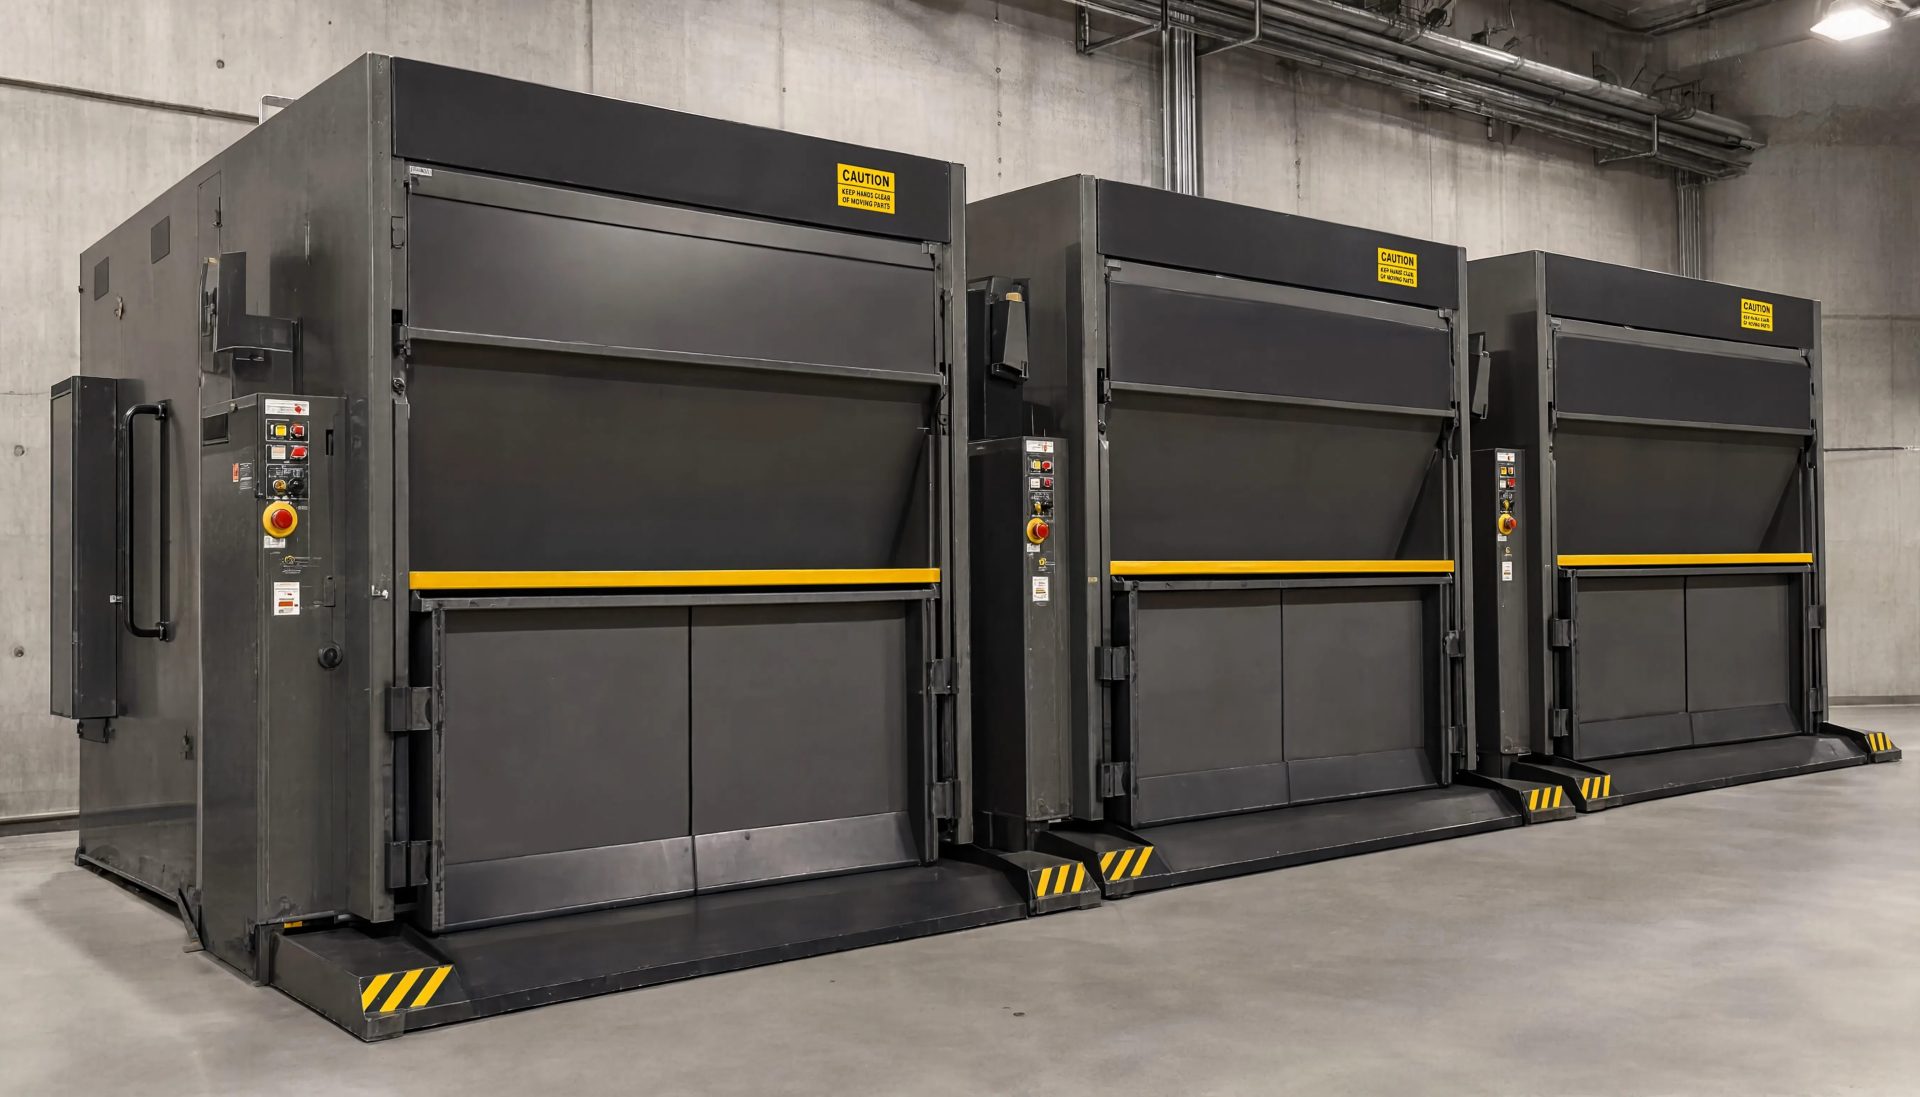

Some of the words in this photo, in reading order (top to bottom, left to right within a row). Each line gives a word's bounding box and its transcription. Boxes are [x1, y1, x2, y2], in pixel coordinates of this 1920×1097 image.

[843, 169, 890, 188] CAUTION
[842, 188, 856, 196] KEEP
[856, 190, 874, 199] HANDS
[874, 192, 891, 202] CLEAR
[850, 198, 873, 208] MOVING
[873, 201, 891, 210] PARTS
[1381, 251, 1414, 267] CAUTION
[1743, 301, 1771, 314] CAUTION
